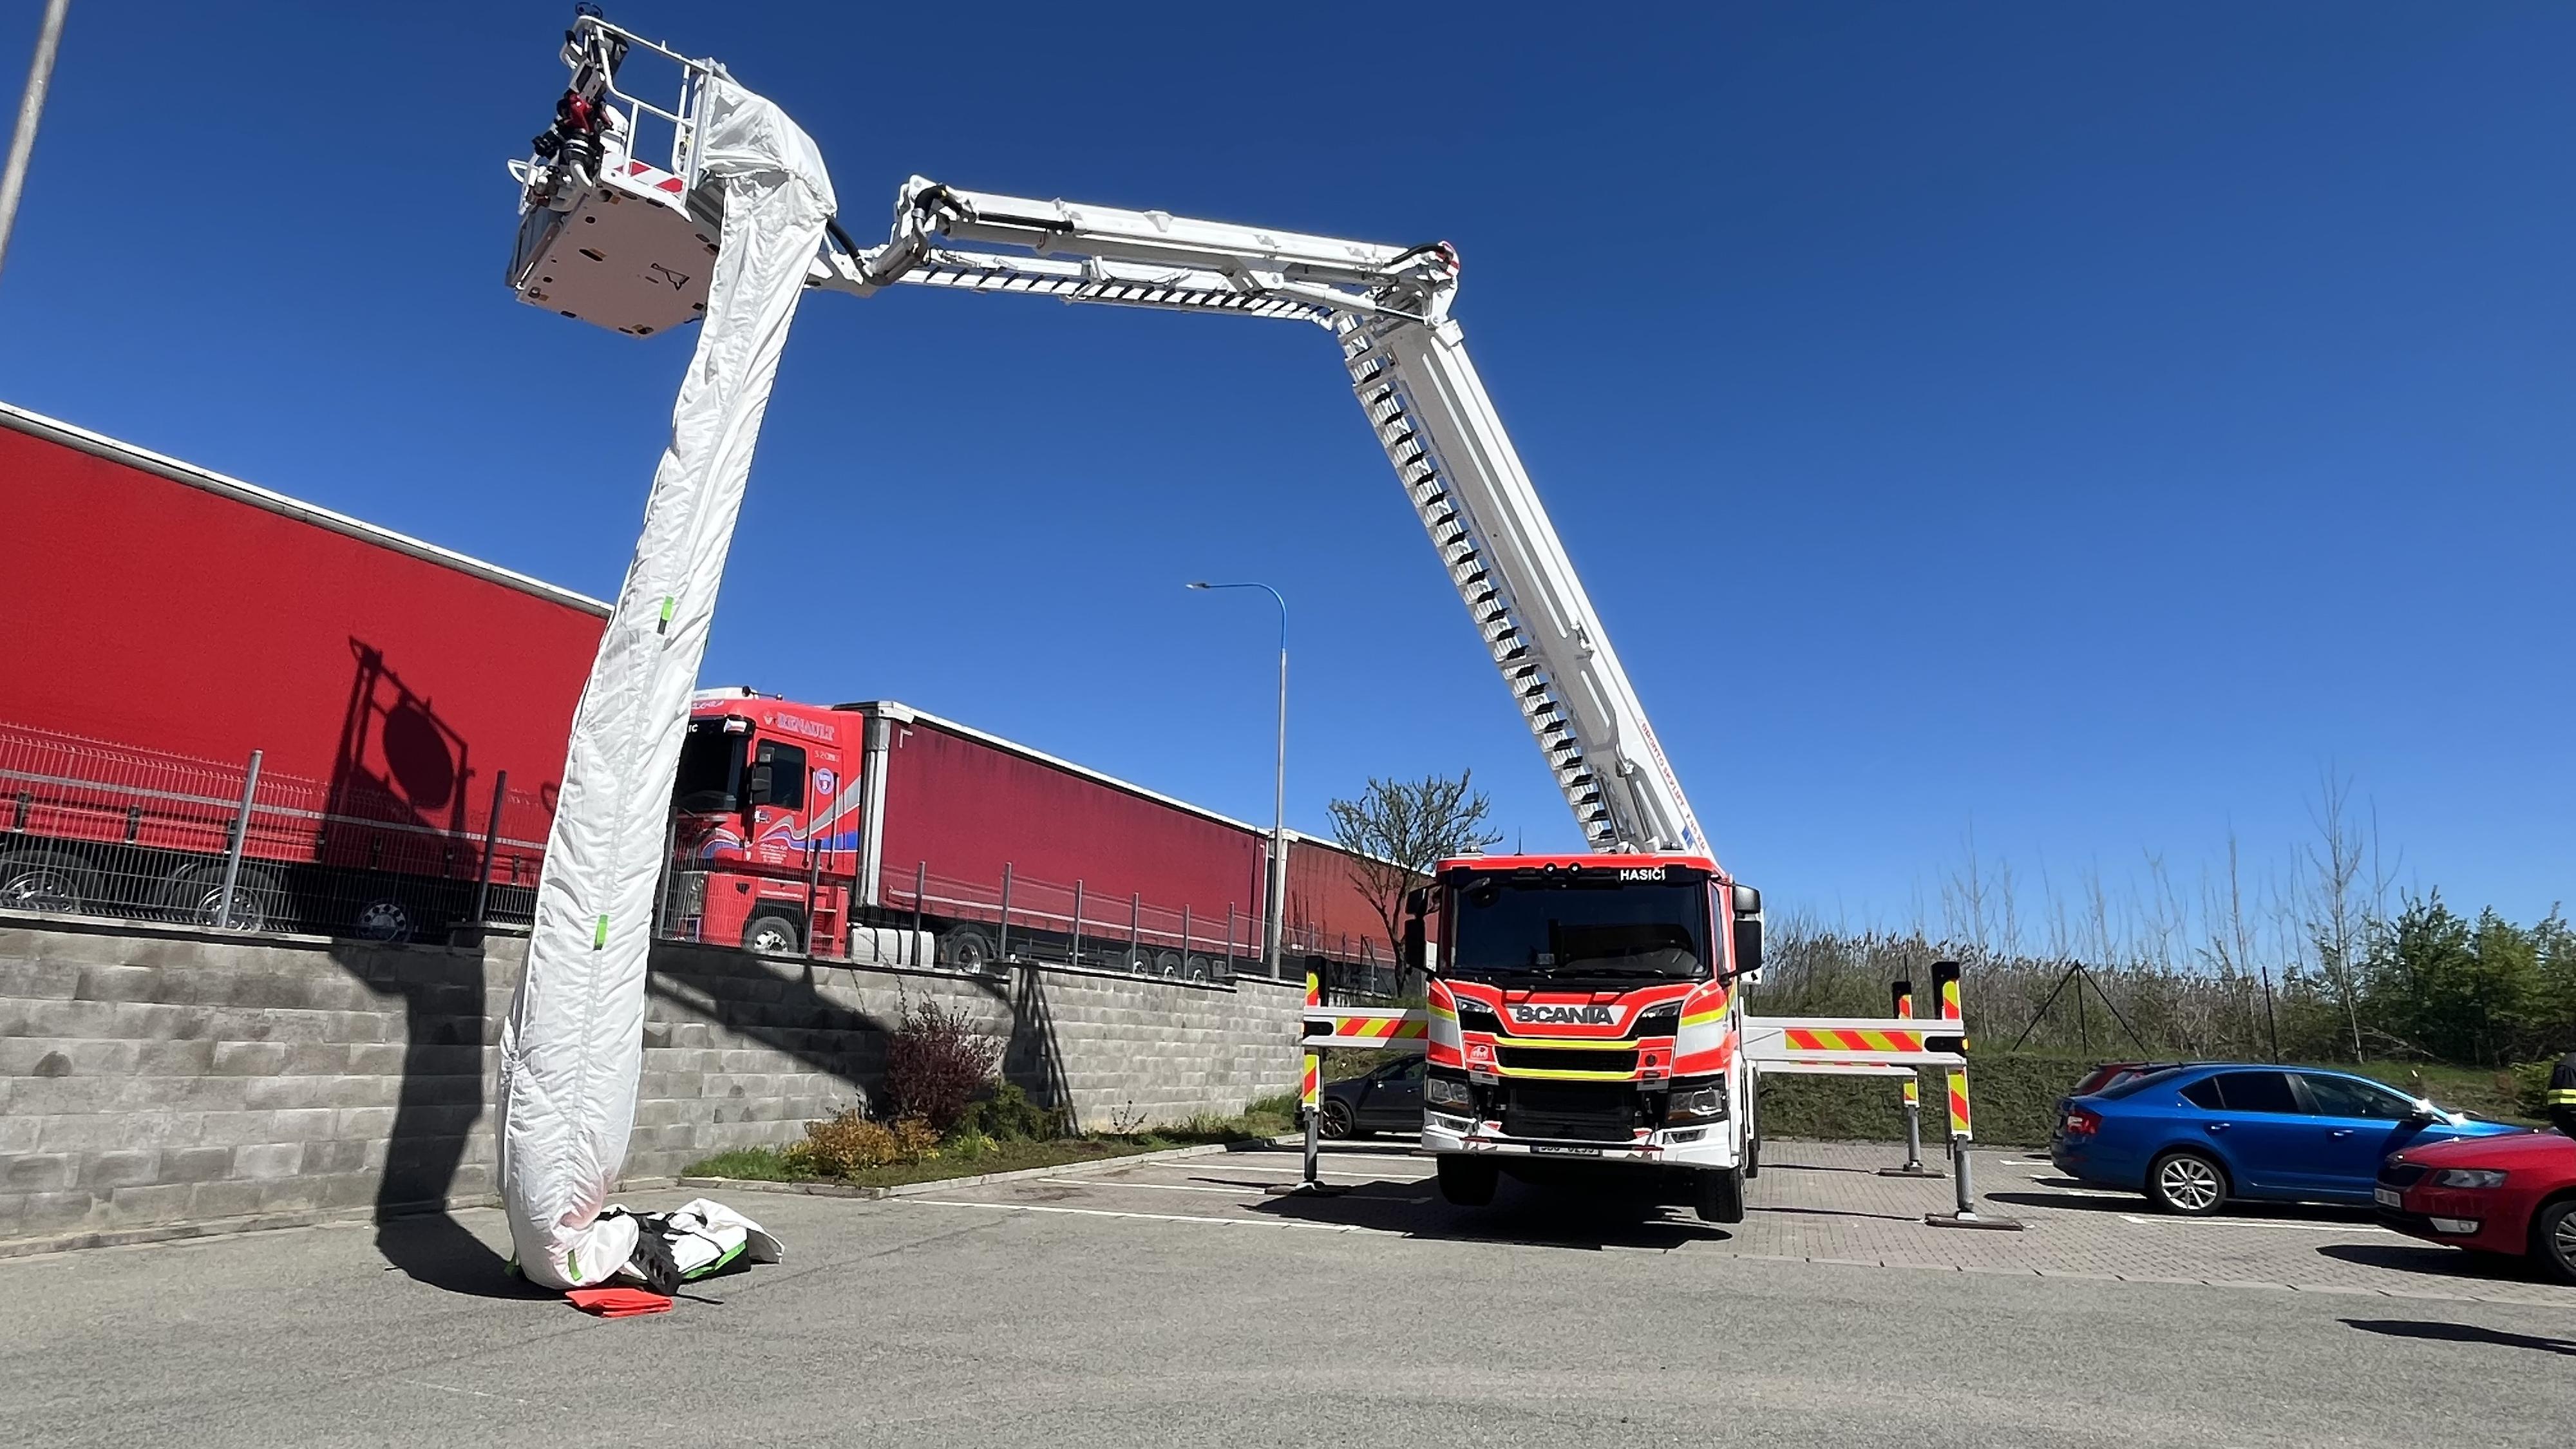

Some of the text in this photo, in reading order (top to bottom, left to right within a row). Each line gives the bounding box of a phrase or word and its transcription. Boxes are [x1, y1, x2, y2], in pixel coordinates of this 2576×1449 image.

[777, 711, 835, 741] RENAULT
[1642, 723, 1664, 766] BRONTO
[1620, 866, 1666, 881] HASIČI
[1516, 1005, 1614, 1025] SCANIA
